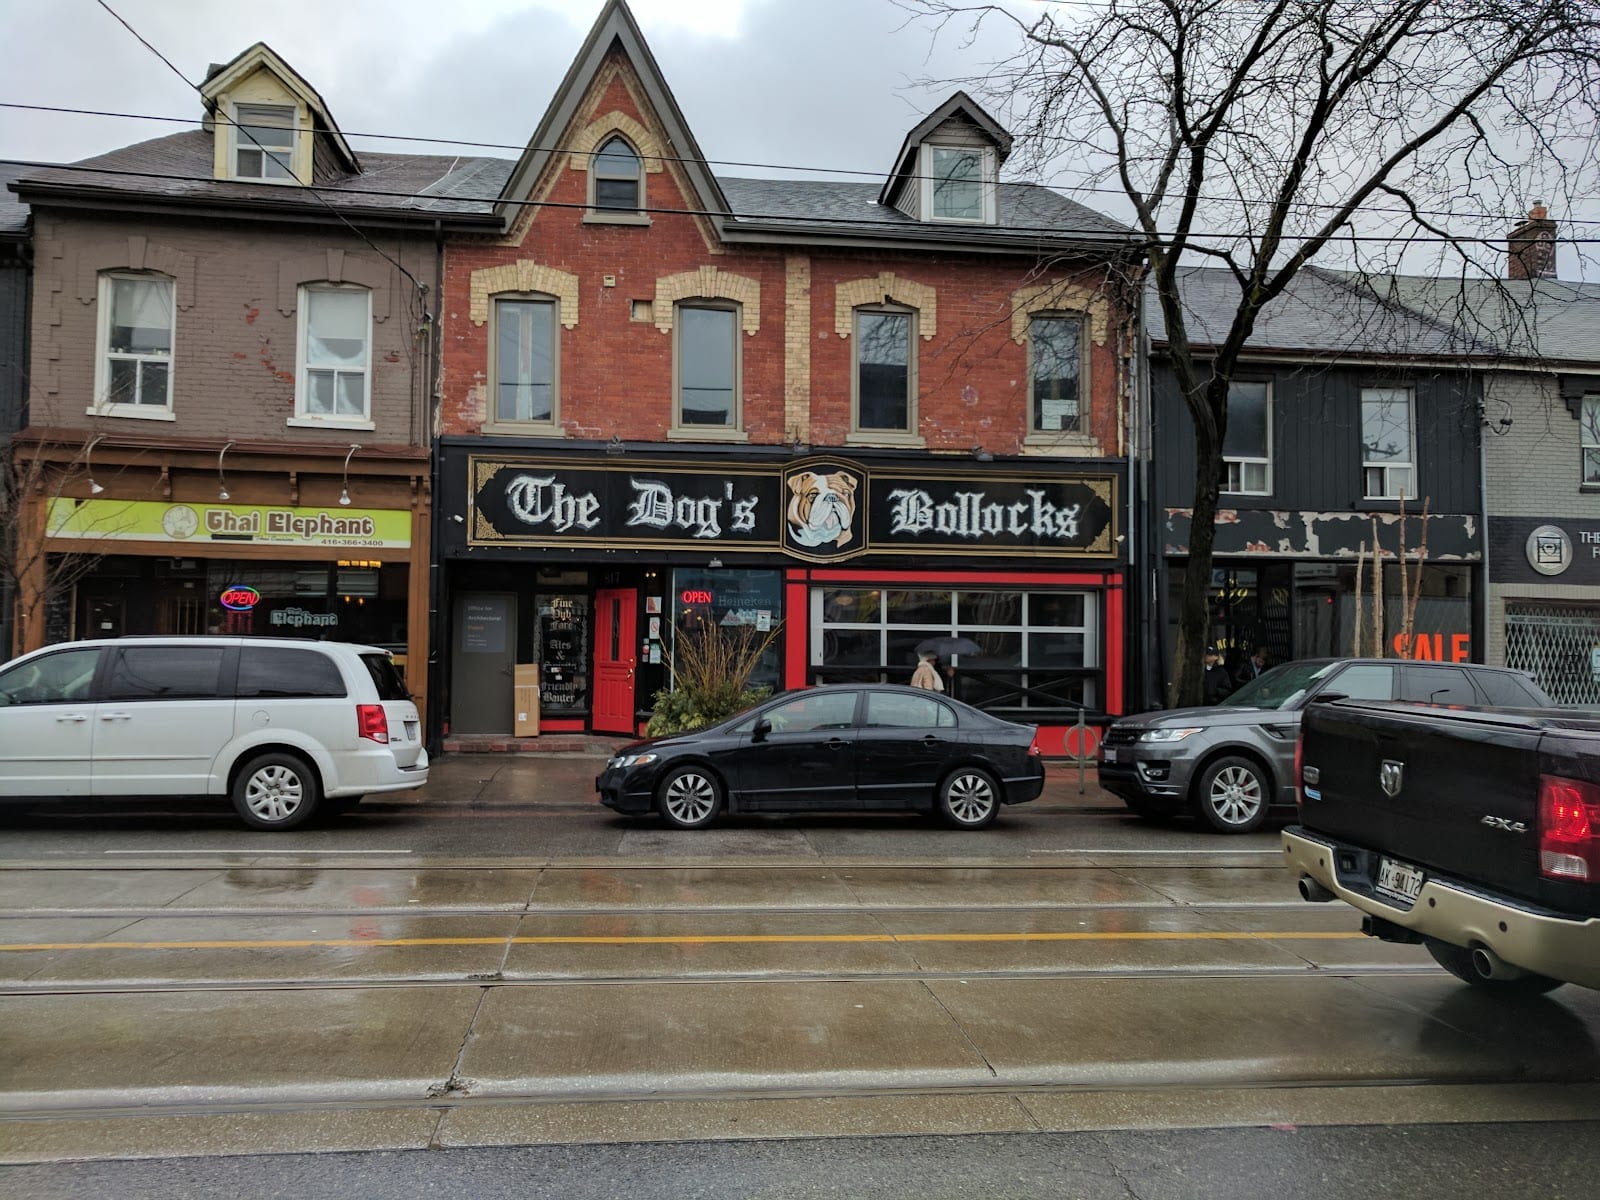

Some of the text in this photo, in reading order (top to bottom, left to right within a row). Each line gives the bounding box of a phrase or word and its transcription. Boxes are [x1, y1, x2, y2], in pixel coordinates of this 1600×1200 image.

[505, 474, 759, 539] The Dog's
[887, 488, 1081, 539] Bollocks
[206, 510, 374, 539] Thai Elephant
[223, 591, 256, 605] OPEN
[551, 598, 573, 609] Fine
[682, 590, 712, 603] OPEN
[718, 595, 772, 608] Heineken
[270, 610, 338, 627] Elephant
[549, 640, 572, 650] Ales
